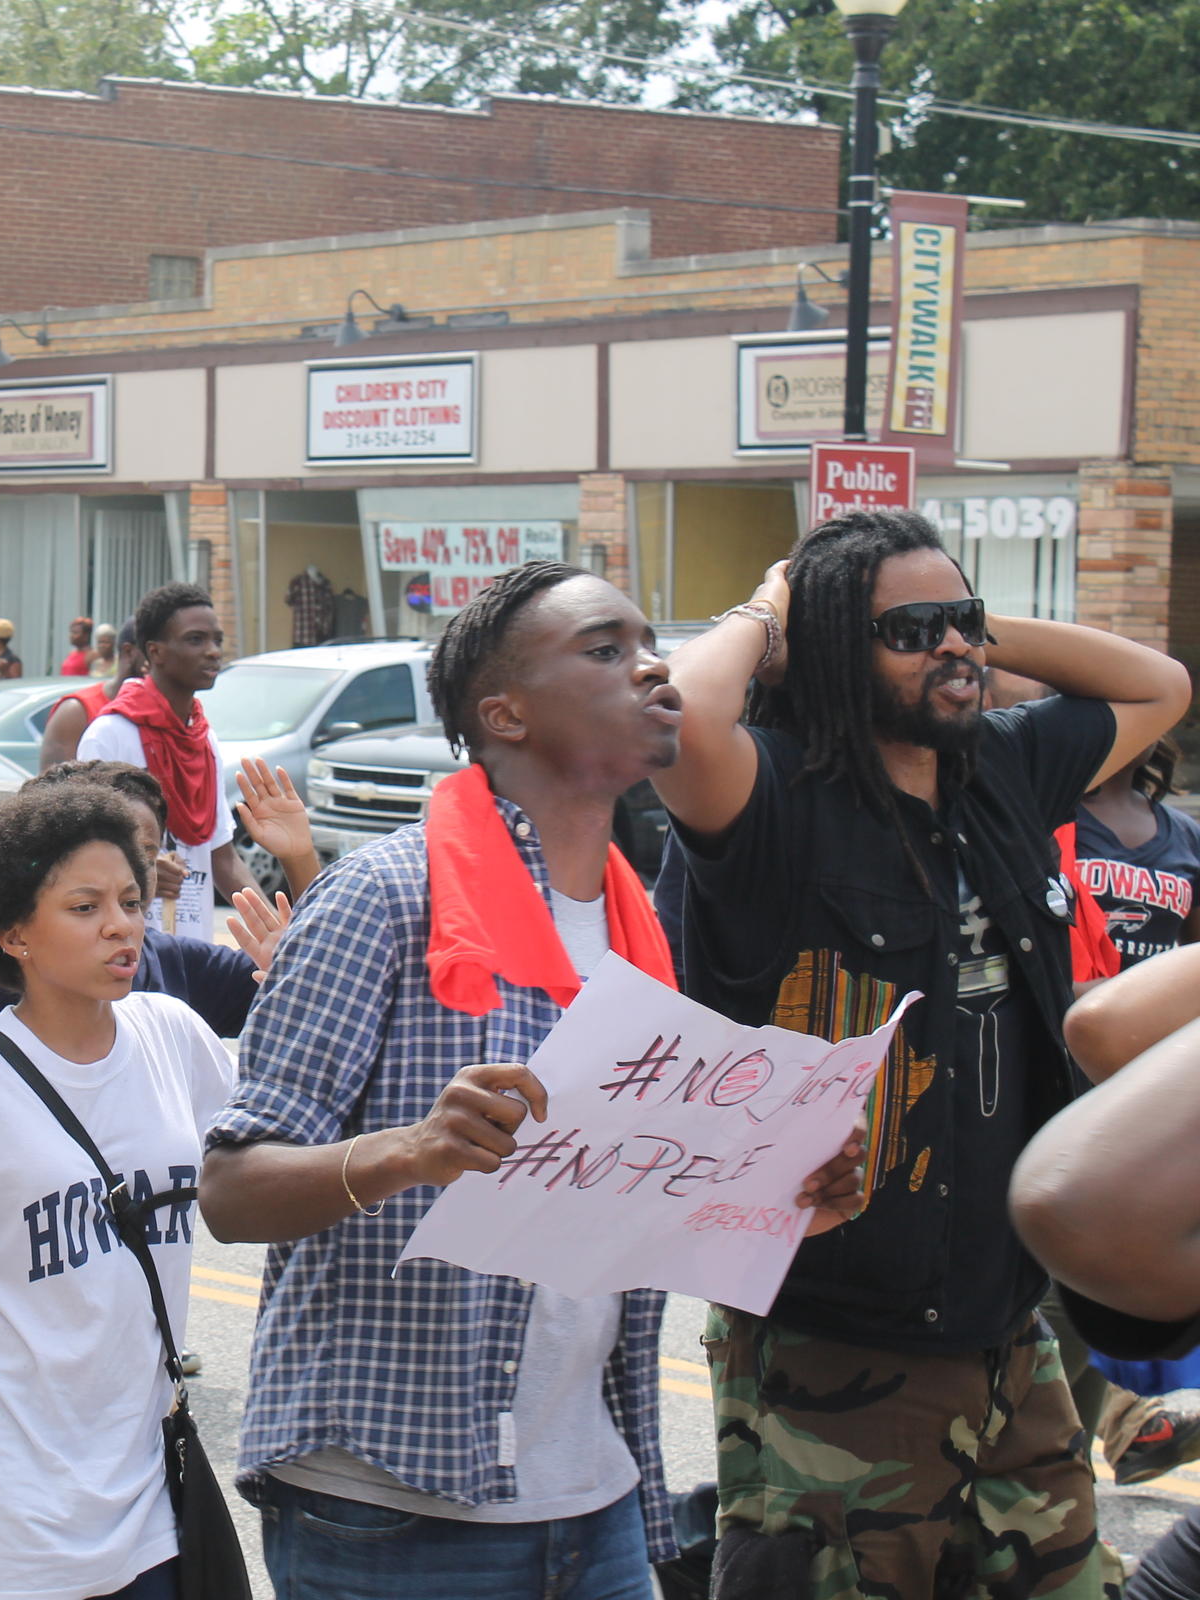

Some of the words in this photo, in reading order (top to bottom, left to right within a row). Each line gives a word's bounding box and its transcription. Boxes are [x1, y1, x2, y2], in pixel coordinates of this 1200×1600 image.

[907, 227, 942, 383] CITYWALK
[336, 381, 413, 403] CHILDREN'S
[416, 379, 448, 400] CITY
[30, 403, 42, 433] of
[44, 404, 83, 440] Honey
[323, 408, 389, 430] DISCOUNT
[393, 404, 461, 426] CLOTHING
[345, 430, 436, 449] 314-524-2254
[825, 461, 897, 492] Public
[383, 528, 417, 564] Save
[461, 528, 494, 565] 75%
[22, 1165, 202, 1284] HOWAR
